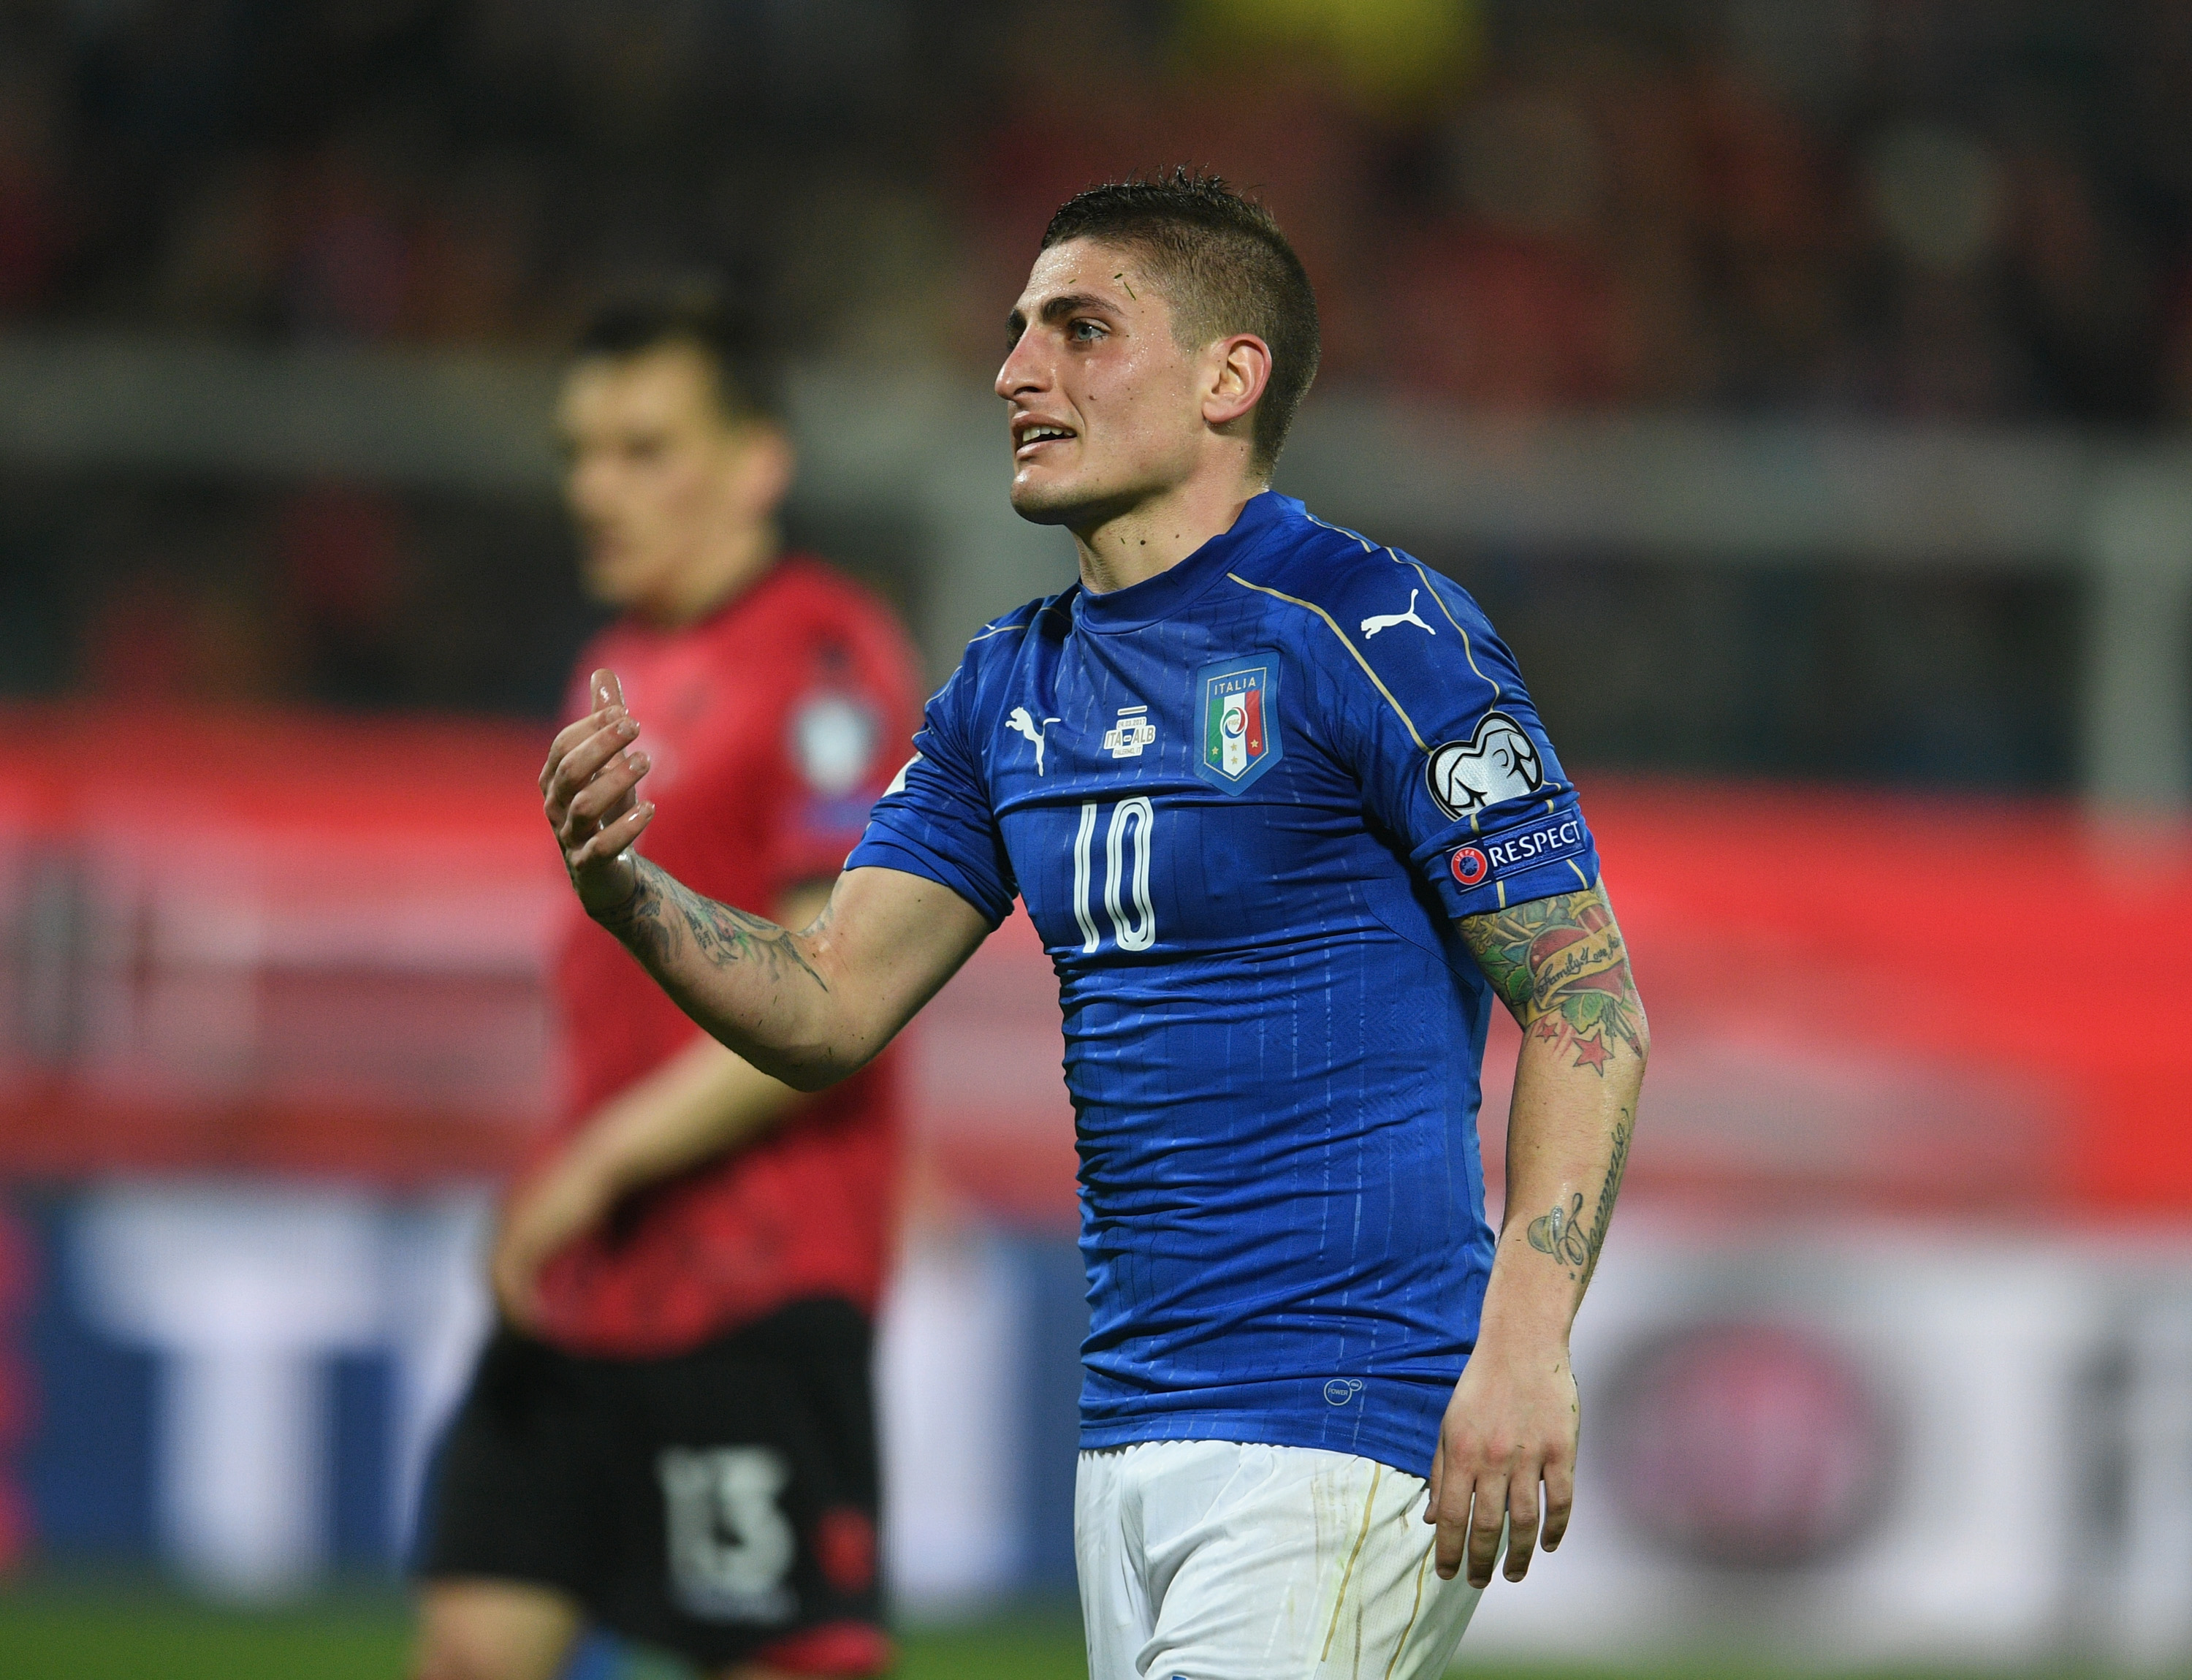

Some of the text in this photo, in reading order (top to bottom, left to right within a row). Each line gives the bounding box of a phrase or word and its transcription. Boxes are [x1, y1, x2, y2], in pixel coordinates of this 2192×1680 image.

[1214, 677, 1256, 695] ITALIA
[1117, 718, 1146, 729] 24.03.2017
[1488, 820, 1581, 867] RESPECT
[1454, 849, 1475, 862] UEFA
[1073, 796, 1156, 953] 10
